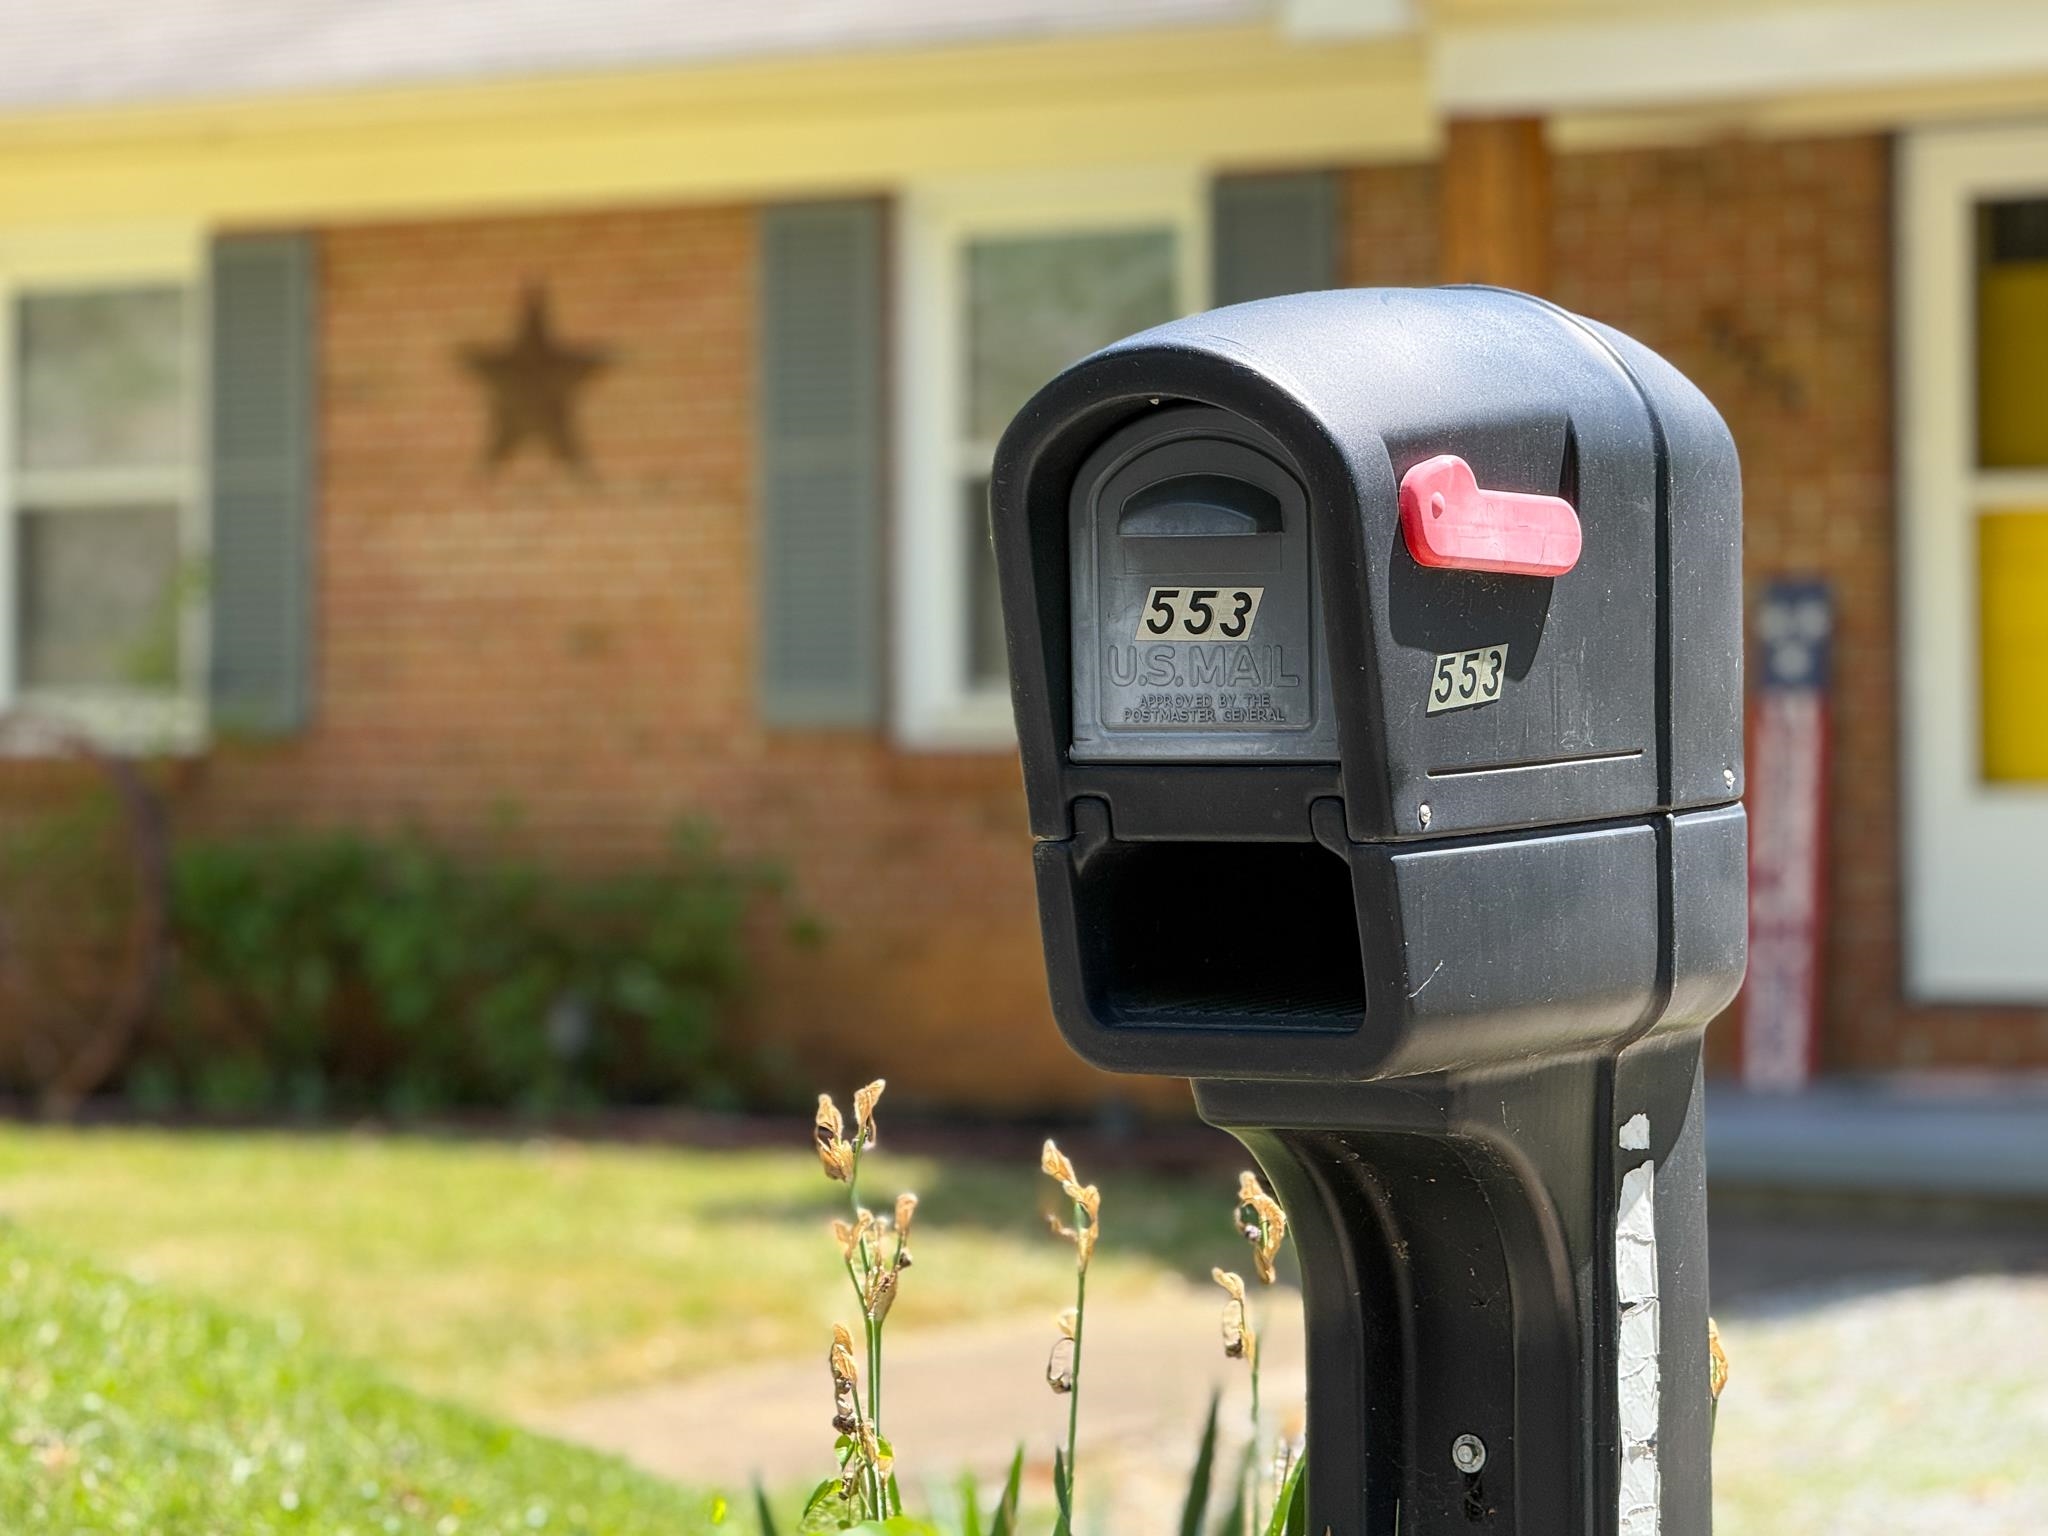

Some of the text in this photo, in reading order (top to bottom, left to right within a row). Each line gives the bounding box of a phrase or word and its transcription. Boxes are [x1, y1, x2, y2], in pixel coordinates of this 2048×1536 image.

[1146, 590, 1252, 638] 553
[1434, 650, 1502, 703] 553
[1123, 708, 1286, 723] POSTMASTER GENERAL
[1139, 693, 1271, 709] APPROVED BY THE
